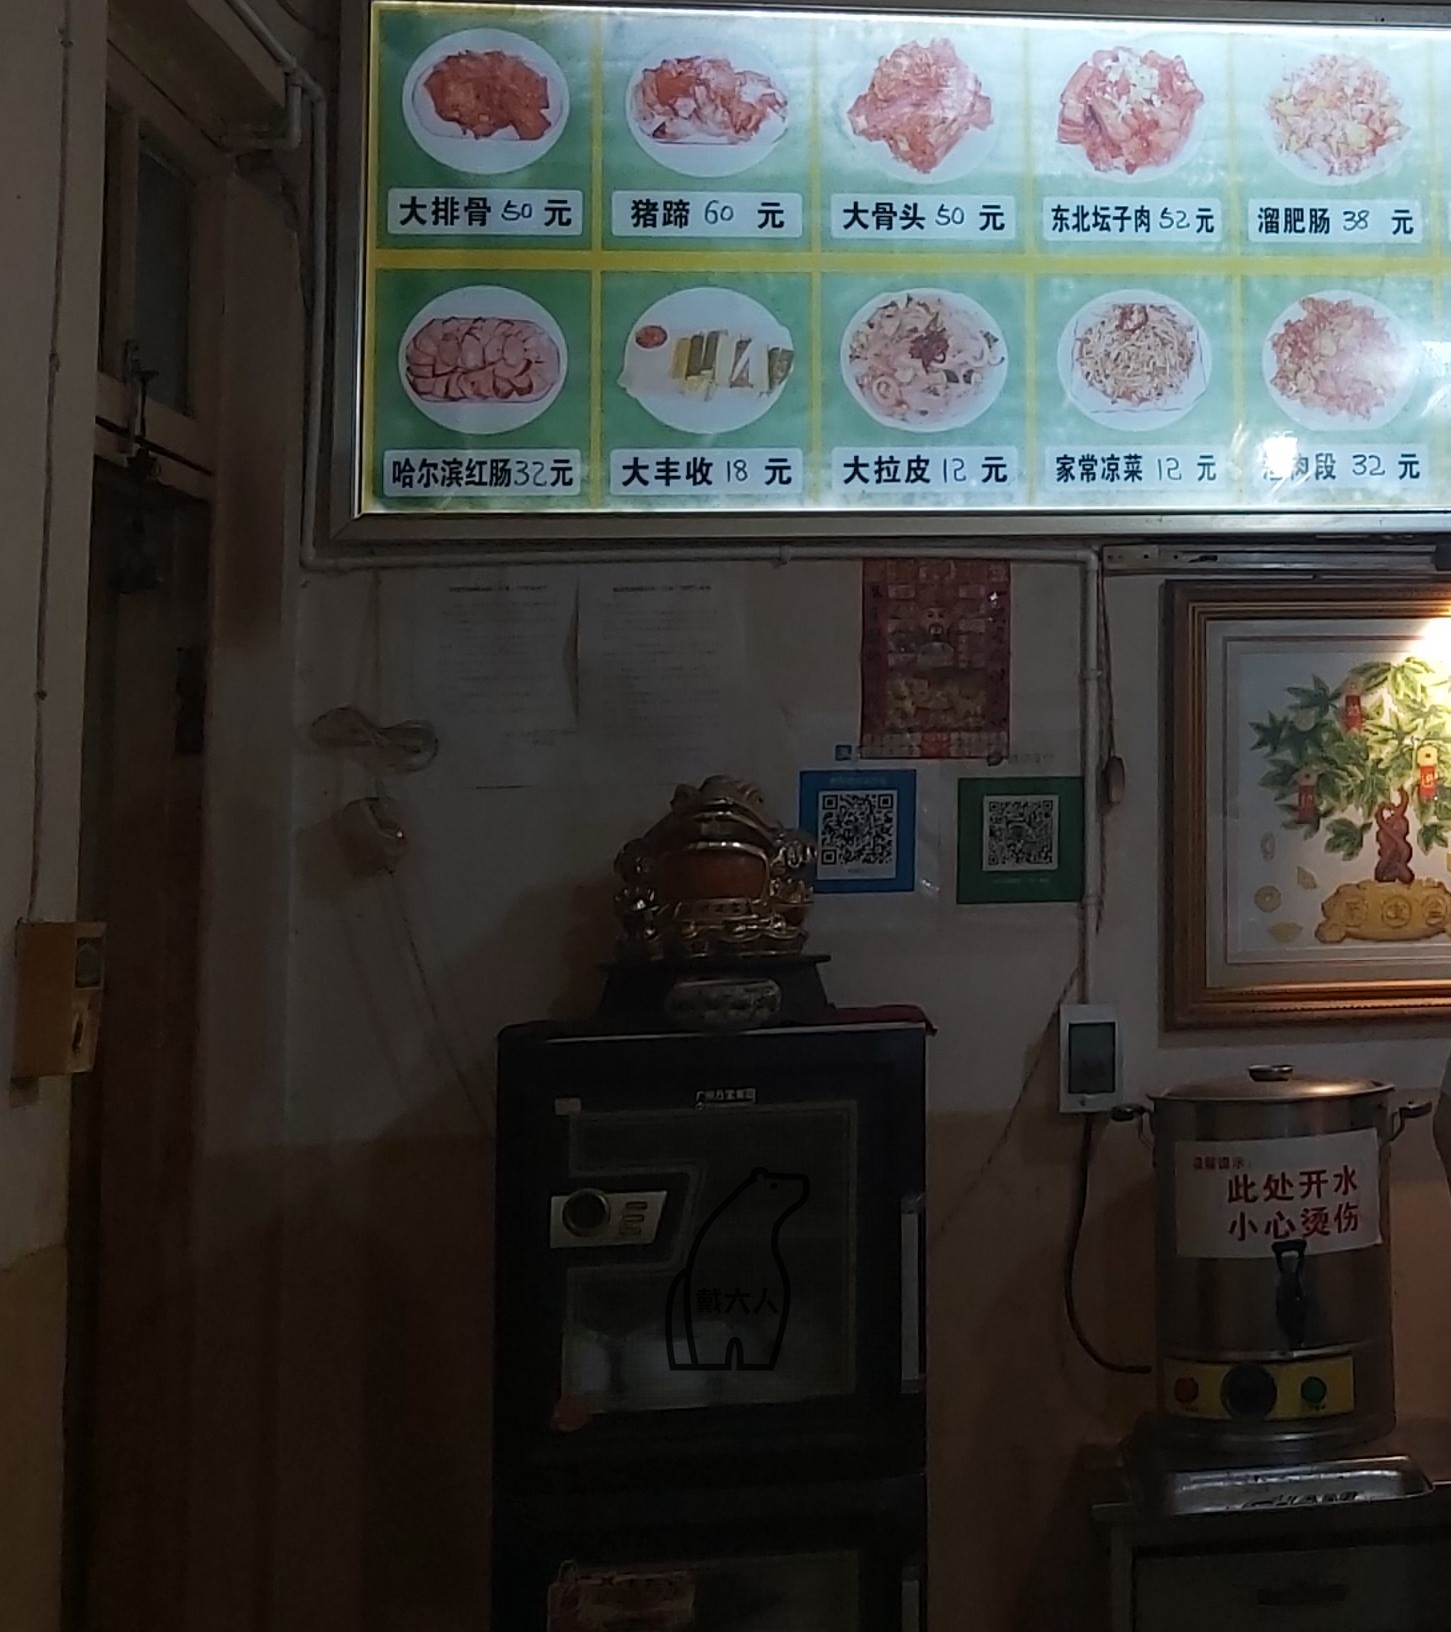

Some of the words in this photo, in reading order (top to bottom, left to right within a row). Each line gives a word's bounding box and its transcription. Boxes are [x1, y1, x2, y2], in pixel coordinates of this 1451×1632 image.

[1227, 1164, 1358, 1204] 此处开水
[1228, 1203, 1360, 1241] 小心烫伤
